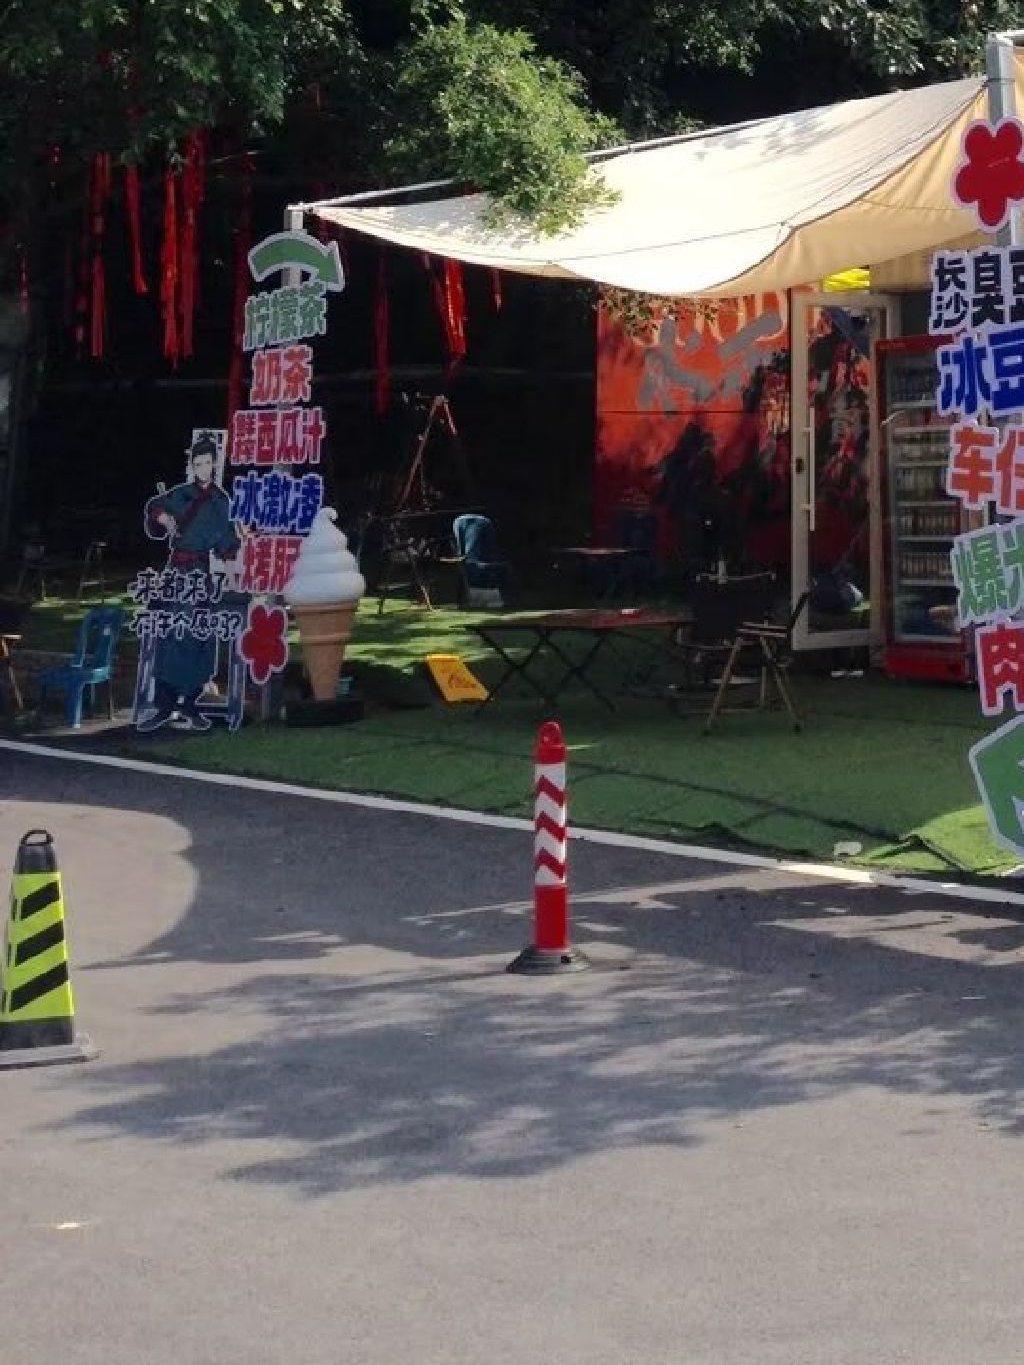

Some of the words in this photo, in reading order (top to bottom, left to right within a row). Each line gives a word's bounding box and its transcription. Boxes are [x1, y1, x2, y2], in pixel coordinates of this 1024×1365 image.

[252, 346, 311, 403] 奶茶
[135, 570, 225, 602] 来都来了
